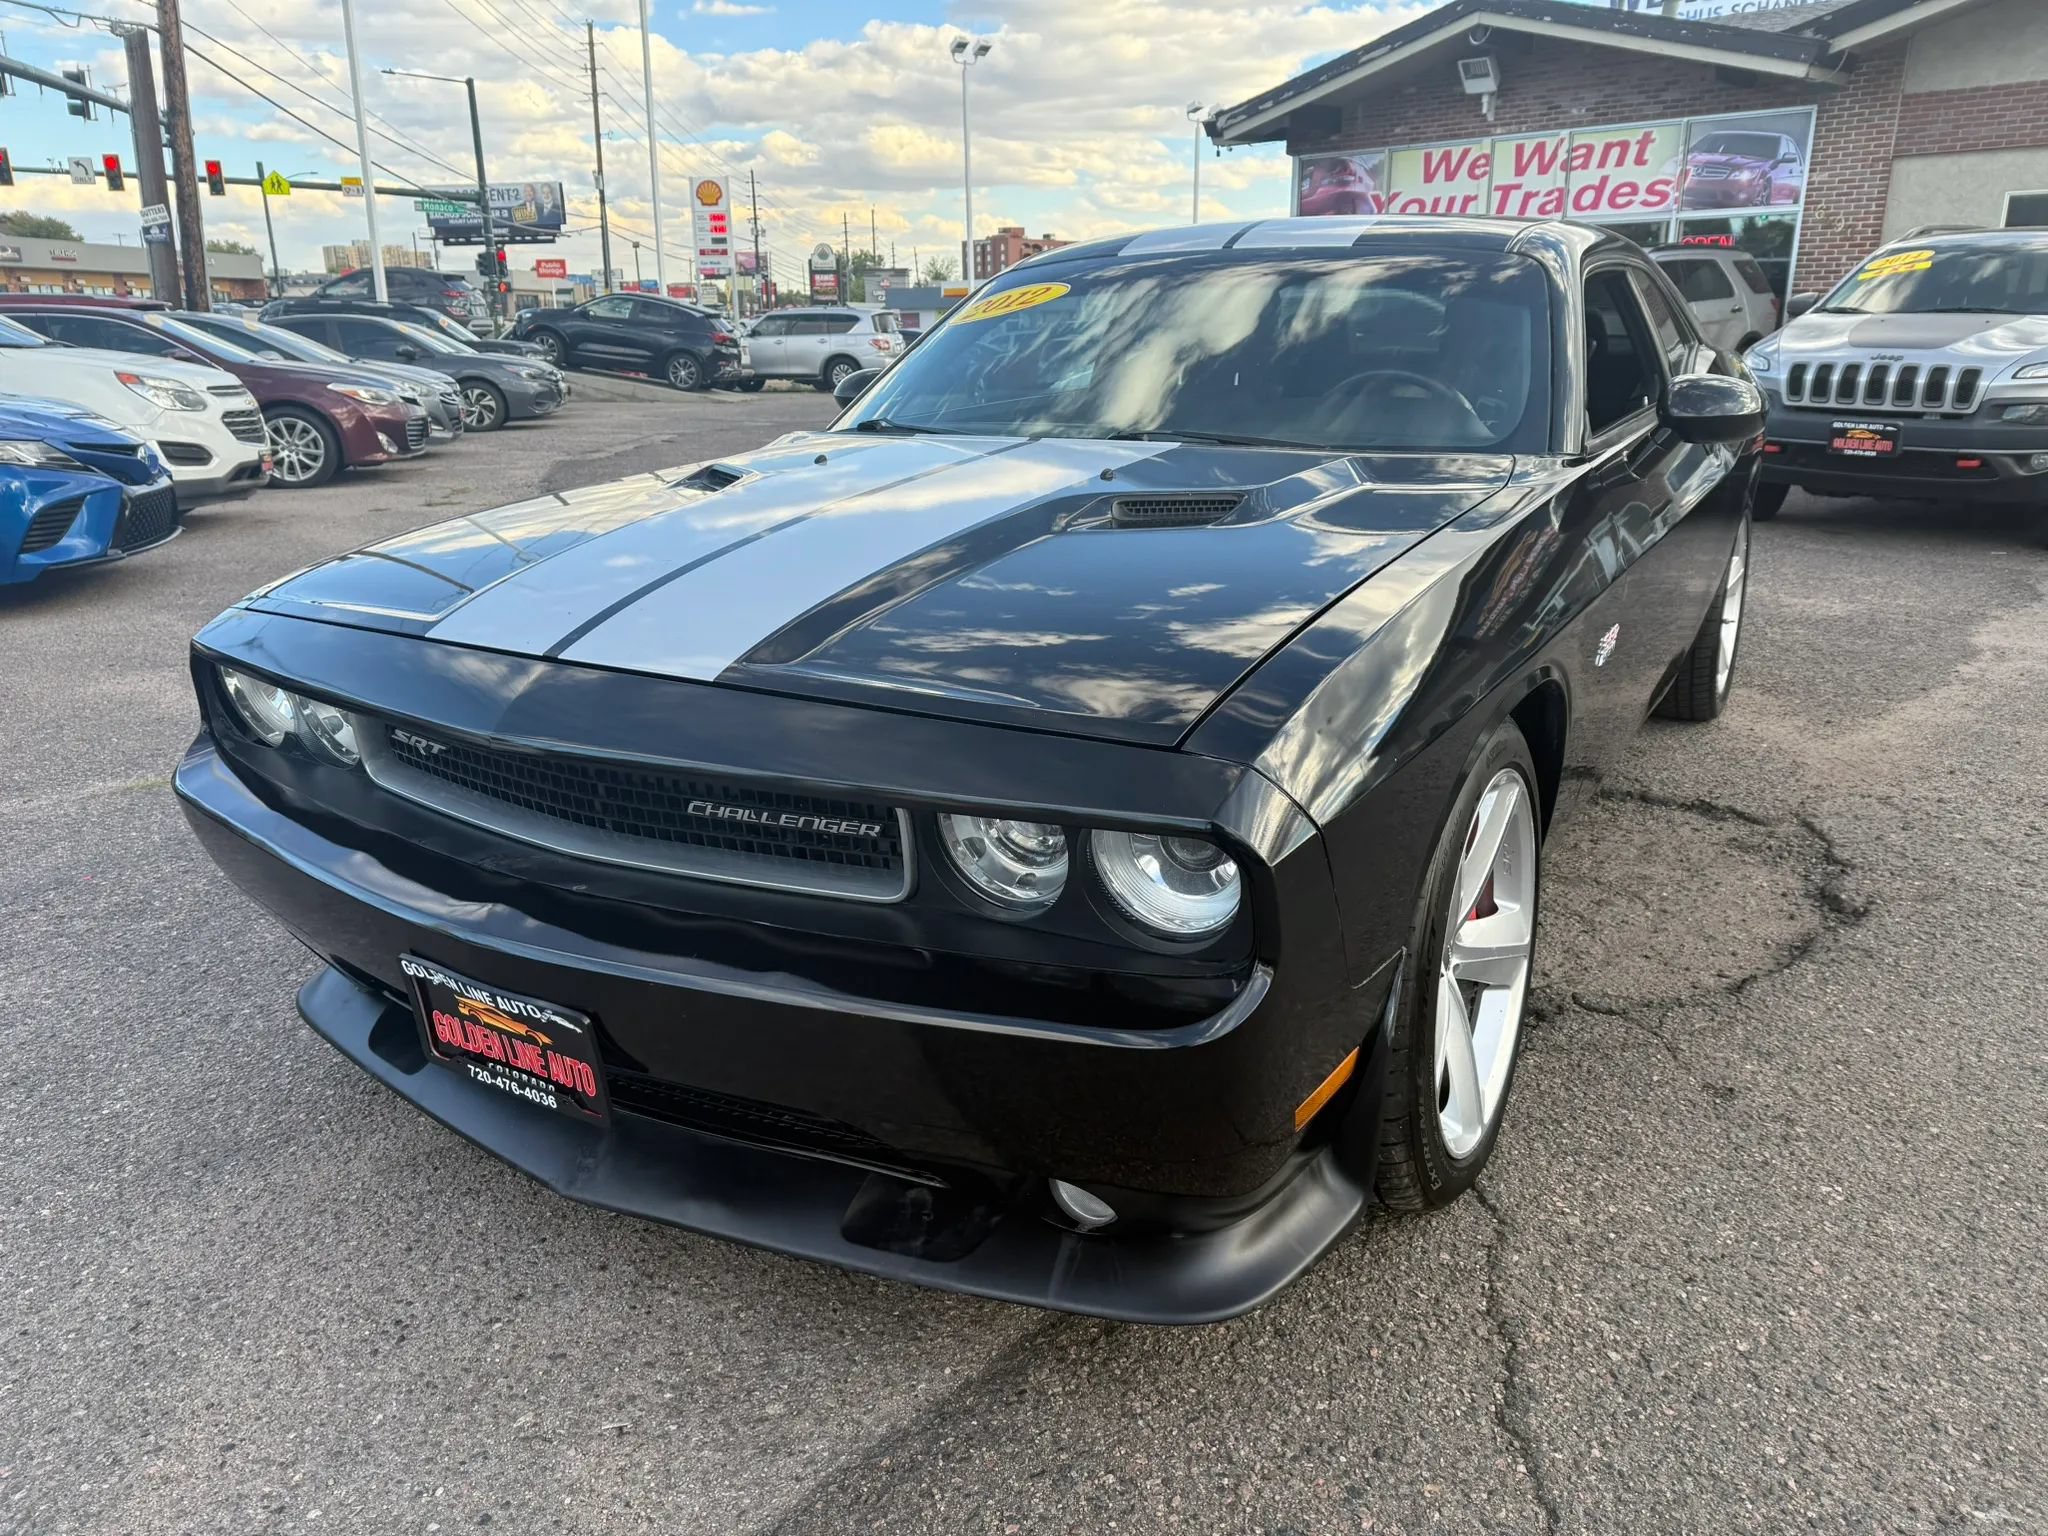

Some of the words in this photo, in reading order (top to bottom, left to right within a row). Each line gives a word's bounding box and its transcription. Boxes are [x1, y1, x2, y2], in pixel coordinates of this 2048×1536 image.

[1422, 146, 1490, 184] We
[1513, 129, 1656, 177] Want
[74, 175, 92, 183] ONLY
[1370, 190, 1480, 215] Your
[1492, 168, 1690, 217] Trades!
[423, 202, 453, 212] Monaco
[1682, 235, 1733, 247] OPEN
[538, 267, 564, 276] Storage
[962, 287, 1054, 320] 2012
[1870, 353, 1905, 362] Jeep
[1833, 421, 1856, 429] GOLDEN
[1856, 422, 1869, 430] LINE
[1869, 423, 1884, 431] AUTO
[1875, 440, 1893, 452] AUTO
[391, 728, 447, 756] SRT
[687, 801, 882, 837] CHALLENGER
[401, 960, 461, 992] GOLDEN
[459, 982, 495, 1007] LINE
[498, 995, 540, 1021] AUTO
[432, 1009, 506, 1062] GOLDEN
[503, 1035, 548, 1077] LINE
[547, 1050, 597, 1098] AUTO
[467, 1064, 558, 1109] 720-476-4036
